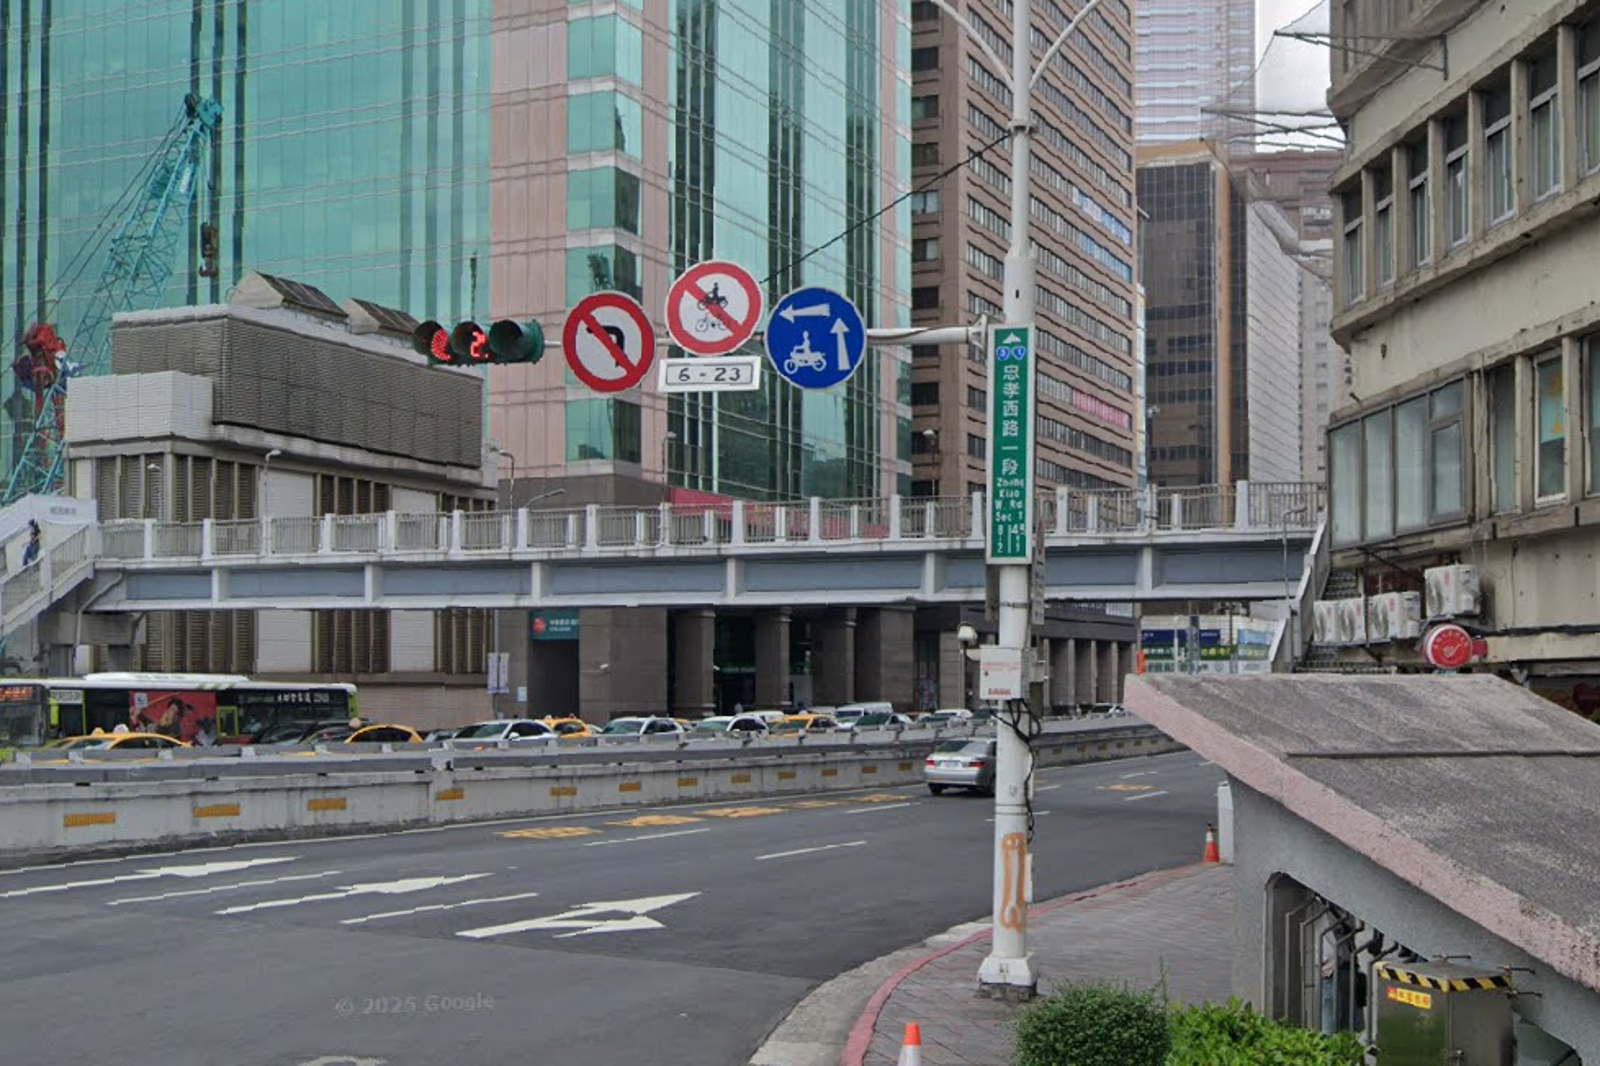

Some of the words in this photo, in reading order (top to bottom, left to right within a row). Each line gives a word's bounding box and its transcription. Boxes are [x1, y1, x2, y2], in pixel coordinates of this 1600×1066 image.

[678, 367, 691, 382] 6
[714, 367, 741, 382] 23
[1002, 365, 1019, 475] 忠孝西路一段
[999, 489, 1020, 498] Xiao
